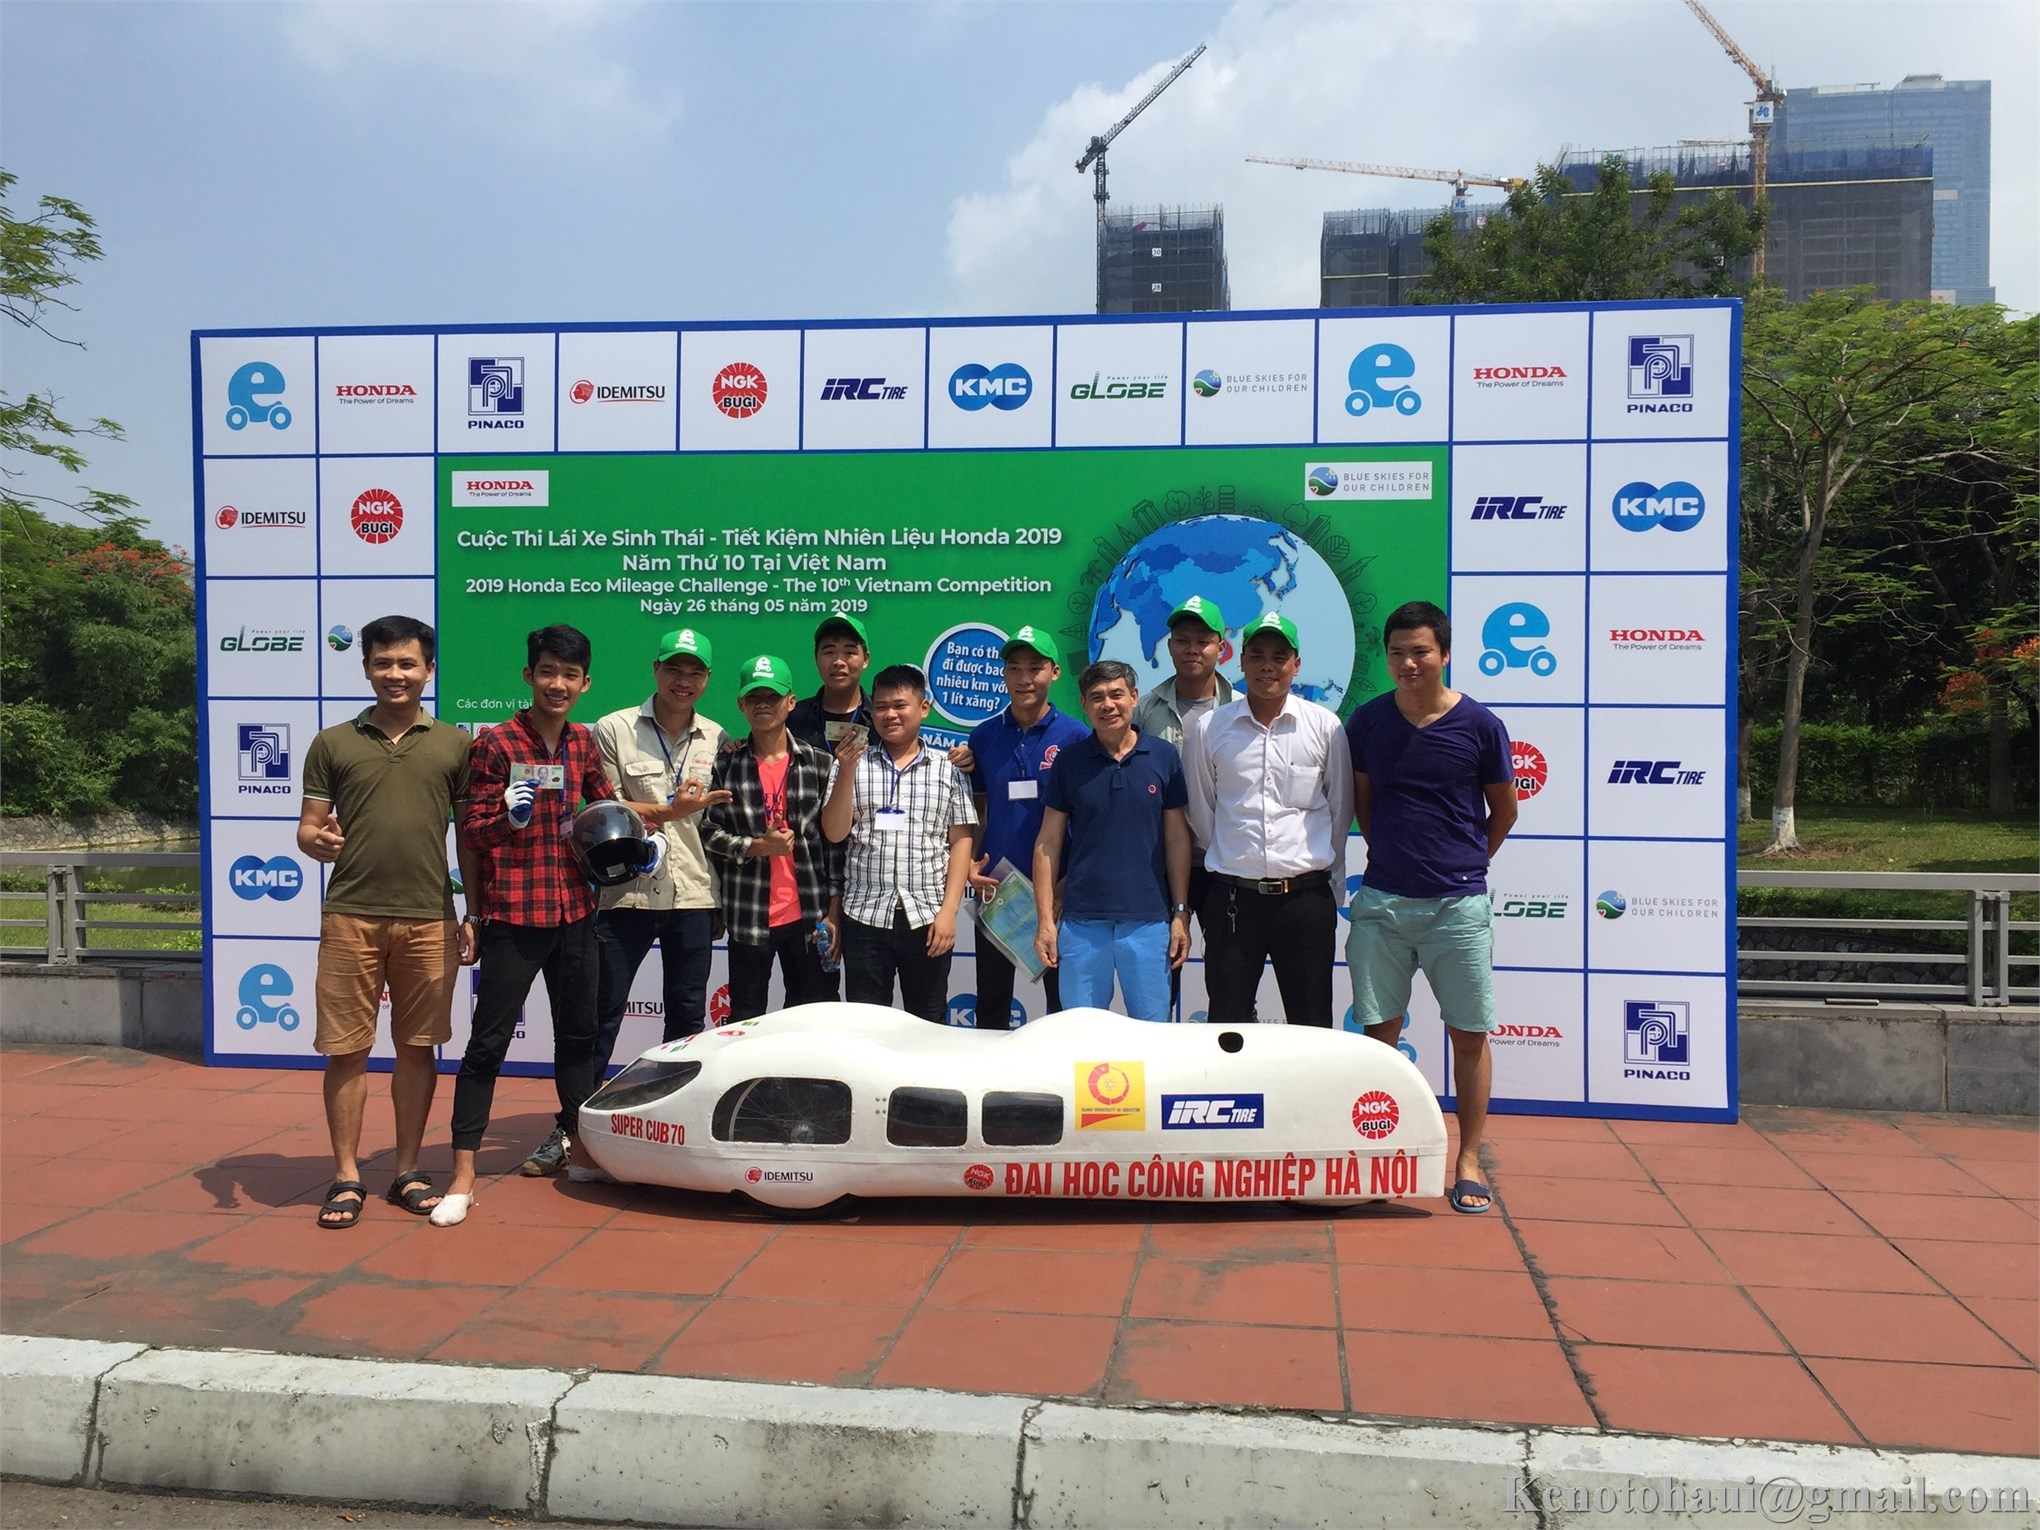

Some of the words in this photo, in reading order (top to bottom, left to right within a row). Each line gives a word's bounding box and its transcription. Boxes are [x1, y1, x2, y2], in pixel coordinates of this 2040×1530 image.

[1226, 374, 1252, 383] BLUE
[1254, 374, 1285, 382] SKIES
[1288, 373, 1308, 382] FOR
[1473, 366, 1567, 380] HONDA
[721, 375, 759, 389] NGK
[956, 378, 1027, 396] KMC
[1070, 371, 1167, 400] GLOBE
[1226, 385, 1248, 394] OUR
[1251, 384, 1308, 393] CHILDREN
[1477, 381, 1493, 389] The
[1532, 380, 1564, 388] Dreams
[336, 385, 417, 397] HONDA
[597, 385, 666, 399] IDEMITSU
[881, 386, 909, 400] TIRE
[723, 397, 756, 408] BUGI
[1627, 403, 1693, 413] PINACO
[468, 420, 525, 429] PINACO
[1343, 472, 1370, 482] BLUE
[1373, 472, 1405, 481] SKIES
[1408, 472, 1429, 481] FOR
[466, 480, 534, 491] HONDA
[1343, 484, 1366, 492] OUR
[1370, 483, 1430, 492] CHILDREN
[358, 500, 395, 516] NGK
[1538, 505, 1568, 520] TIRE
[1620, 497, 1699, 516] KMC
[241, 511, 306, 525] IDEMITSU
[361, 522, 393, 534] BUGI
[457, 529, 508, 550] Cuộc
[512, 529, 543, 546] Thi
[548, 529, 577, 546] Lái
[582, 530, 608, 546] Xe
[612, 528, 656, 546] Sinh
[661, 529, 704, 546] Thái
[722, 526, 760, 546] Tiết
[765, 528, 819, 550] Kiệm
[824, 528, 885, 546] Nhiên
[891, 527, 935, 550] Liệu
[940, 527, 1010, 545] Honda
[1015, 527, 1062, 545] 2019
[622, 554, 671, 571] Năm
[677, 554, 719, 571] Thứ
[723, 554, 745, 571] 10
[750, 553, 781, 575] Tại
[787, 553, 830, 575] Việt
[836, 554, 887, 571] Nam
[465, 578, 504, 593] 2019
[508, 578, 566, 593] Honda
[570, 578, 602, 593] Eco
[606, 577, 674, 596] Mileage
[679, 577, 768, 596] Challenge
[783, 578, 817, 593] The
[855, 577, 932, 593] Vietnam
[937, 576, 1052, 596] Competition
[641, 599, 683, 615] Ngày
[686, 599, 706, 612] 26
[710, 599, 760, 615] tháng
[764, 599, 785, 612] 05
[790, 599, 826, 612] năm
[831, 599, 868, 612] 2019
[220, 625, 305, 652] GLOBE
[1609, 629, 1705, 642] HONDA
[947, 641, 969, 658] Bạn
[971, 645, 984, 658] có
[986, 646, 1002, 660] th
[1669, 643, 1702, 651] Dreams
[942, 657, 954, 671] đi
[956, 659, 984, 677] được
[936, 674, 969, 689] nhiêu
[971, 677, 989, 692] km
[456, 698, 478, 709] Các
[480, 698, 503, 709] đơn
[506, 699, 516, 711] vị
[942, 692, 949, 704] 1
[950, 691, 964, 705] lít
[965, 694, 1001, 712] xăng?
[922, 733, 954, 748] NĂM
[1511, 754, 1538, 769] GK
[1675, 770, 1706, 785] TIRE
[238, 785, 291, 794] PINACO
[234, 869, 298, 888] KMC
[1489, 888, 1568, 919] LOBE
[1631, 897, 1659, 907] BLUE
[1662, 898, 1694, 907] SKIES
[1697, 898, 1718, 907] FOR
[1631, 908, 1655, 917] OUR
[1658, 908, 1718, 918] CHILDREN
[624, 1001, 663, 1014] MITSU
[950, 1008, 1021, 1028] KC
[1487, 1024, 1563, 1038] ONDA
[1489, 1038, 1516, 1046] Power
[1527, 1039, 1560, 1048] Dreams
[1624, 1069, 1691, 1081] PINACO
[1358, 1100, 1392, 1114] NGK
[1230, 1108, 1258, 1124] TIRE
[611, 1113, 643, 1139] SUPER
[1362, 1119, 1391, 1132] BUGI
[764, 1171, 814, 1182] IDEMITSU
[970, 1167, 991, 1180] NGK
[1127, 1153, 1204, 1198] CÔNG
[1214, 1152, 1316, 1200] NGHIỆP
[1325, 1150, 1362, 1196] HÀ
[1370, 1149, 1418, 1199] NỘI
